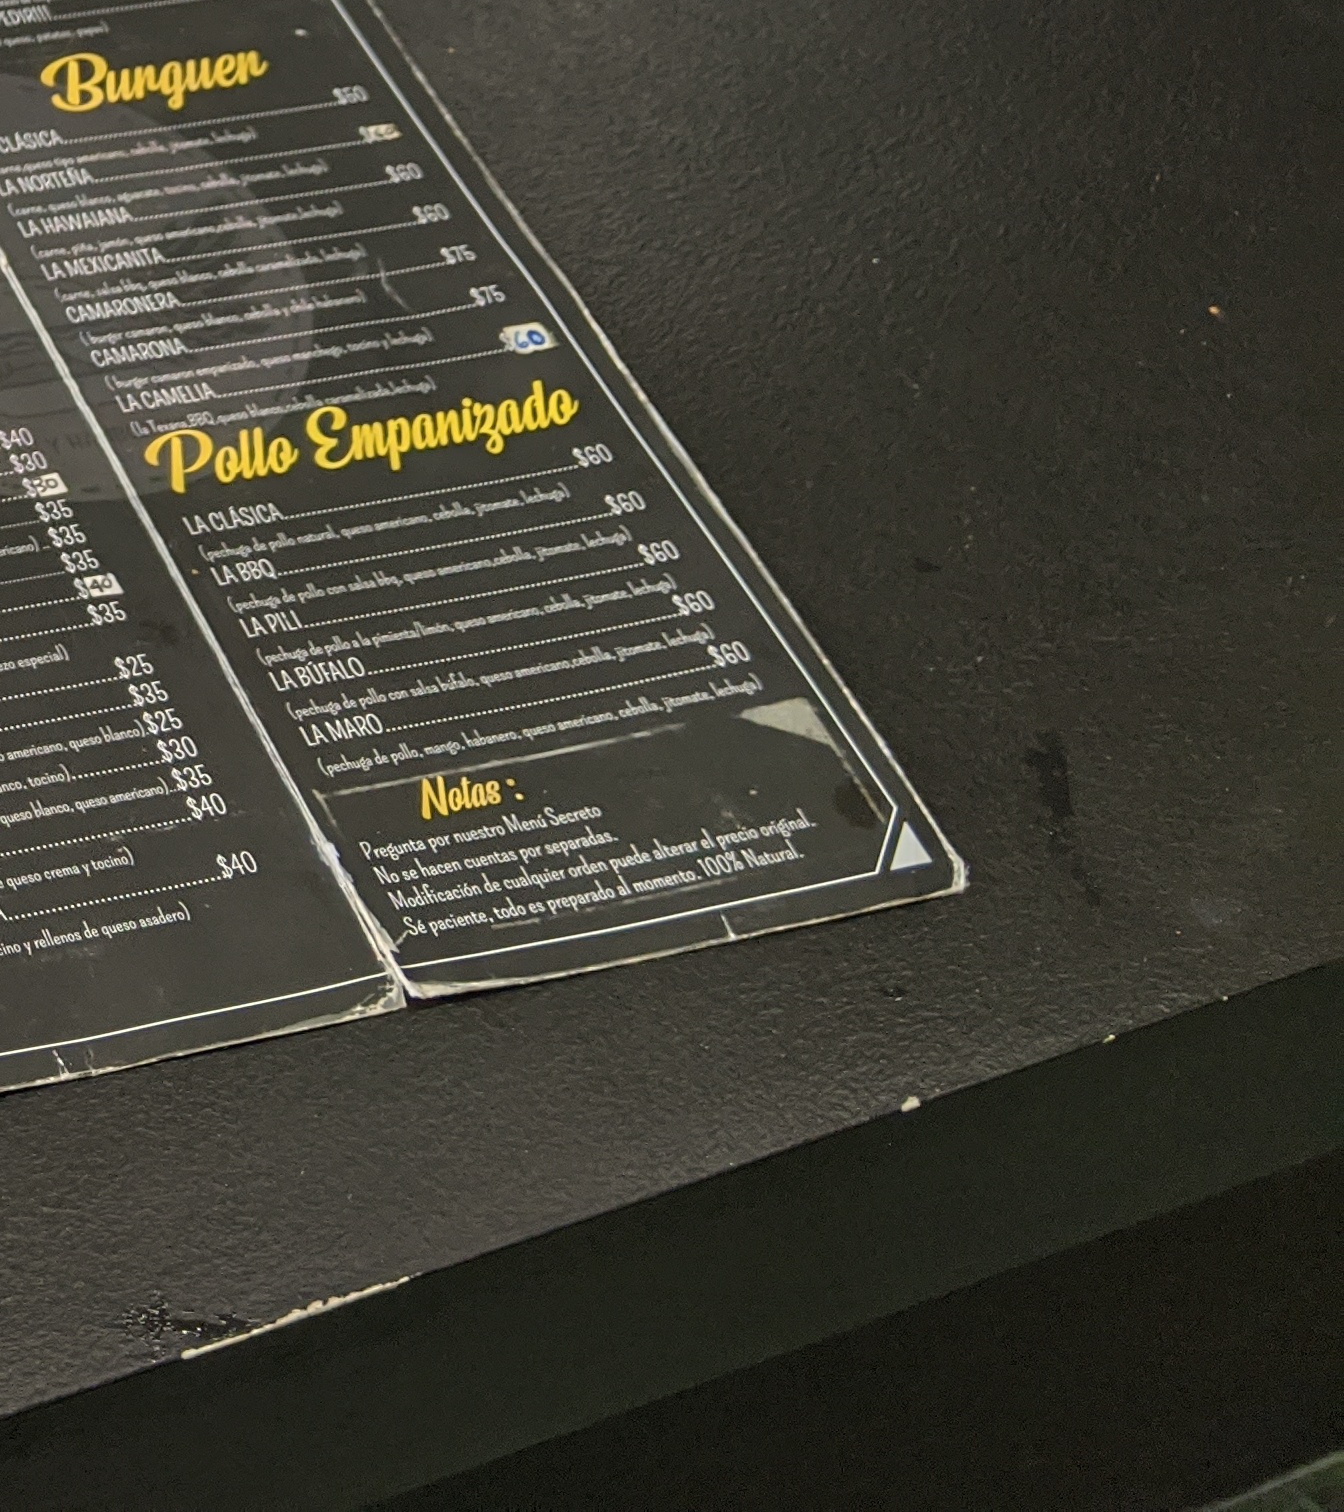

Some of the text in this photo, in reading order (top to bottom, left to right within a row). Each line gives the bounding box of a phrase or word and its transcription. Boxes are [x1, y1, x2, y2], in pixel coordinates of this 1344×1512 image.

[39, 260, 67, 282] LA
[62, 246, 168, 278] MEXICANITA
[64, 290, 184, 324] CAMARONERA
[89, 336, 191, 368] CAMARONA
[142, 426, 300, 495] Pollo
[303, 378, 580, 472] Empanizado
[7, 449, 48, 474] $30
[181, 442, 613, 536] LA CLÁSICA $60
[33, 497, 74, 523] $35
[46, 522, 87, 548] $35
[208, 489, 646, 586] LA BBQ $60
[59, 548, 100, 574] $35
[237, 538, 680, 639] LA PILI $60
[85, 599, 127, 626] $35
[266, 589, 715, 692] LA BÚFALO $60
[113, 652, 154, 680] $25
[126, 679, 169, 707] $35
[297, 639, 751, 747] LA MARO $60
[141, 706, 184, 735] $25
[155, 734, 198, 763] $30
[169, 762, 213, 792] $35
[184, 791, 227, 821] $40
[419, 774, 502, 821] Notas
[357, 805, 602, 861] Pregunta por nuestro Menú Secreto
[215, 849, 258, 879] $40
[371, 824, 619, 885] No se hacen cuentas por separadas.
[385, 806, 817, 910] Modificación de cualquier orden puede alterar el precio original.
[401, 837, 805, 937] Sé paciente, todo es preparado al momento. 100% Natural.
